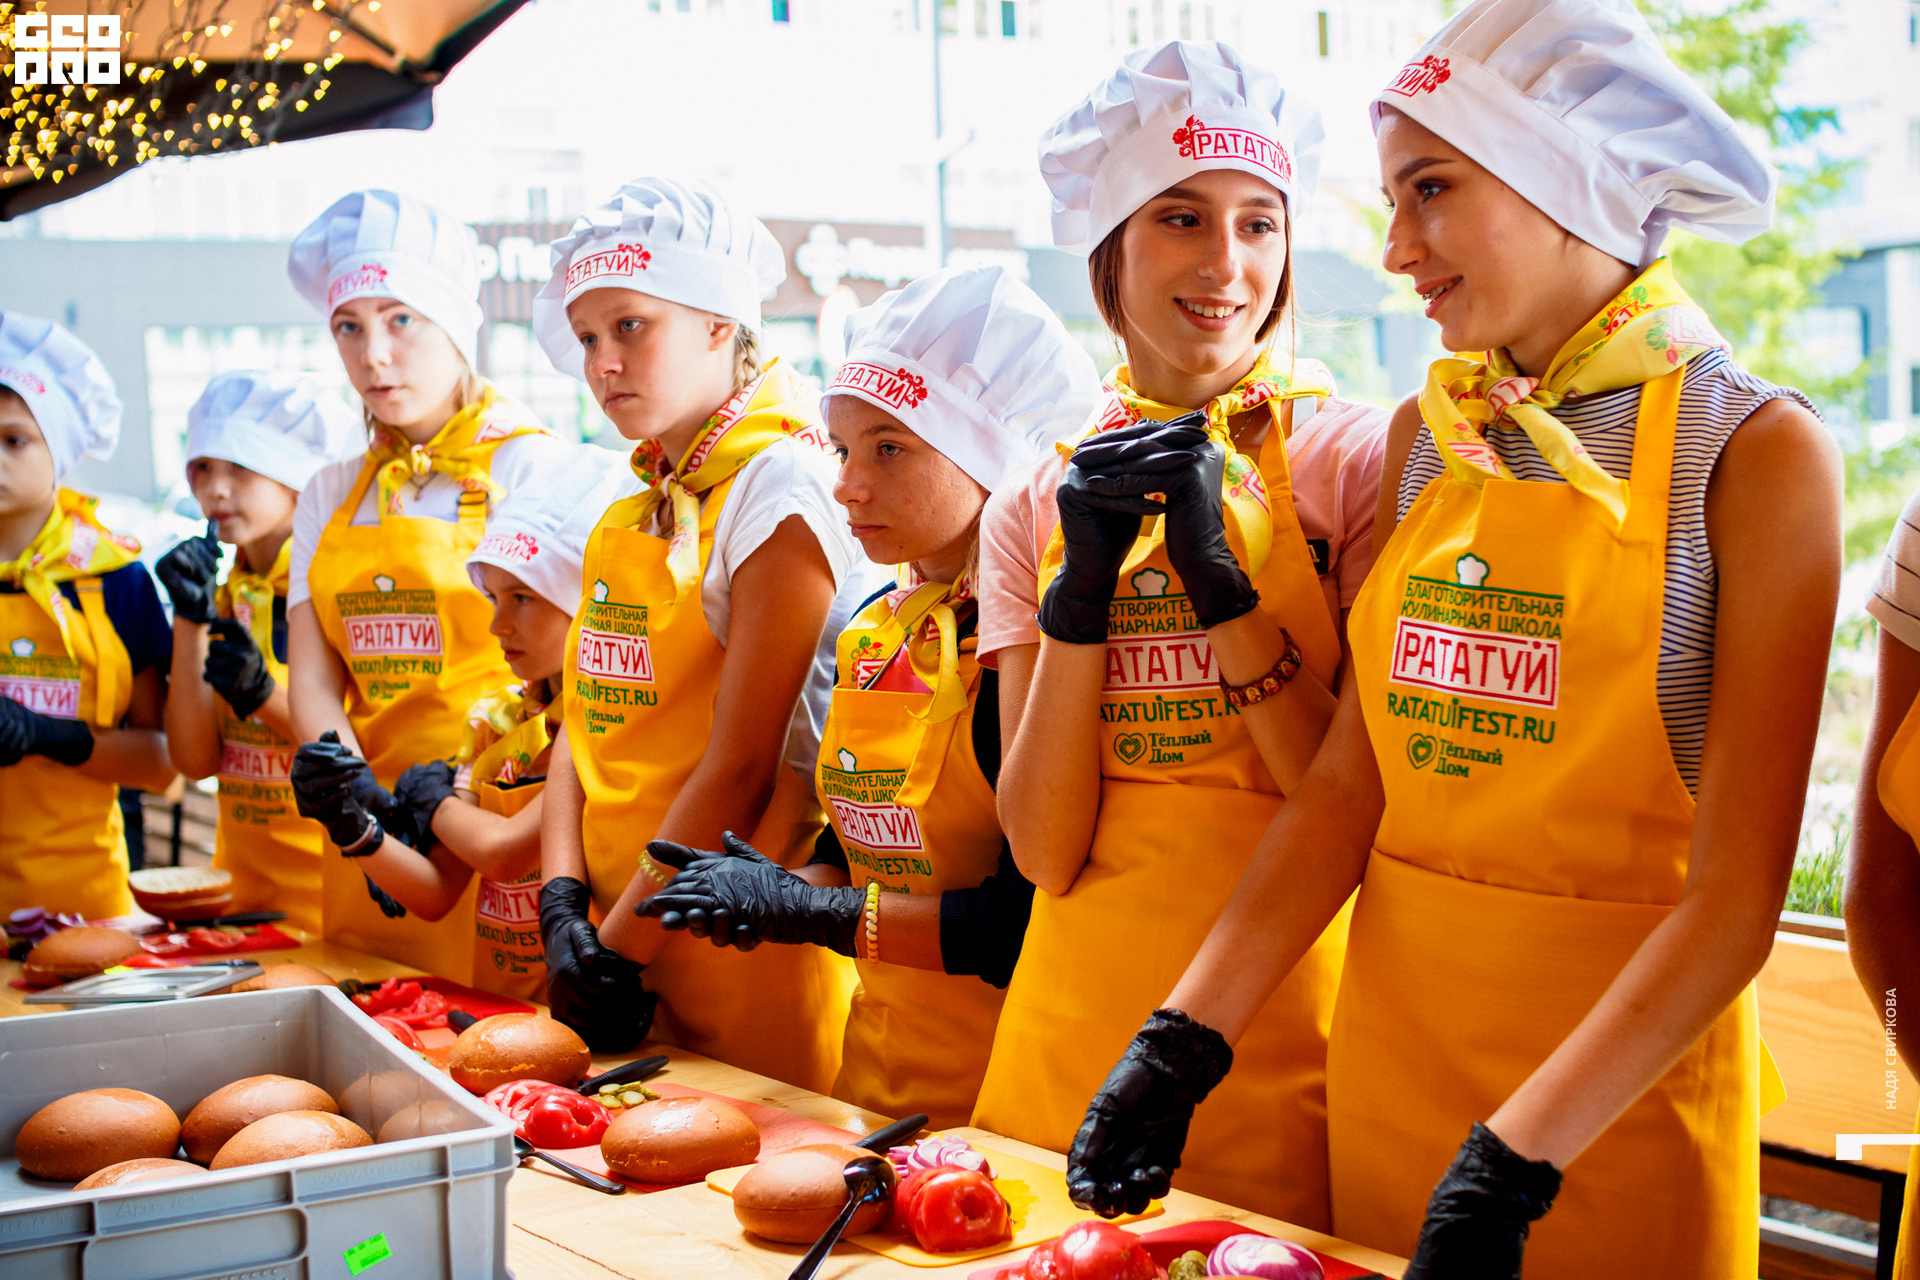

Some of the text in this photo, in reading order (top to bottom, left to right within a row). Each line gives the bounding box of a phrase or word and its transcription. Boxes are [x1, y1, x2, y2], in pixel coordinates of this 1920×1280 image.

[1405, 582, 1564, 618] БЛАГОТВОРИТЕЛЬНАЯ
[351, 617, 436, 648] РАТАТУЙ
[614, 620, 648, 637] ШКОЛА
[1400, 600, 1563, 639] КУЛИНАРНАЯ ШКОЛА
[1401, 631, 1548, 696] РАТАТУЙ
[1148, 730, 1212, 747] Тёплый
[1438, 738, 1504, 765] Тёплый
[1148, 749, 1184, 764] Дом
[1433, 756, 1470, 778] Дом
[835, 804, 916, 843] РАТАТУЙ
